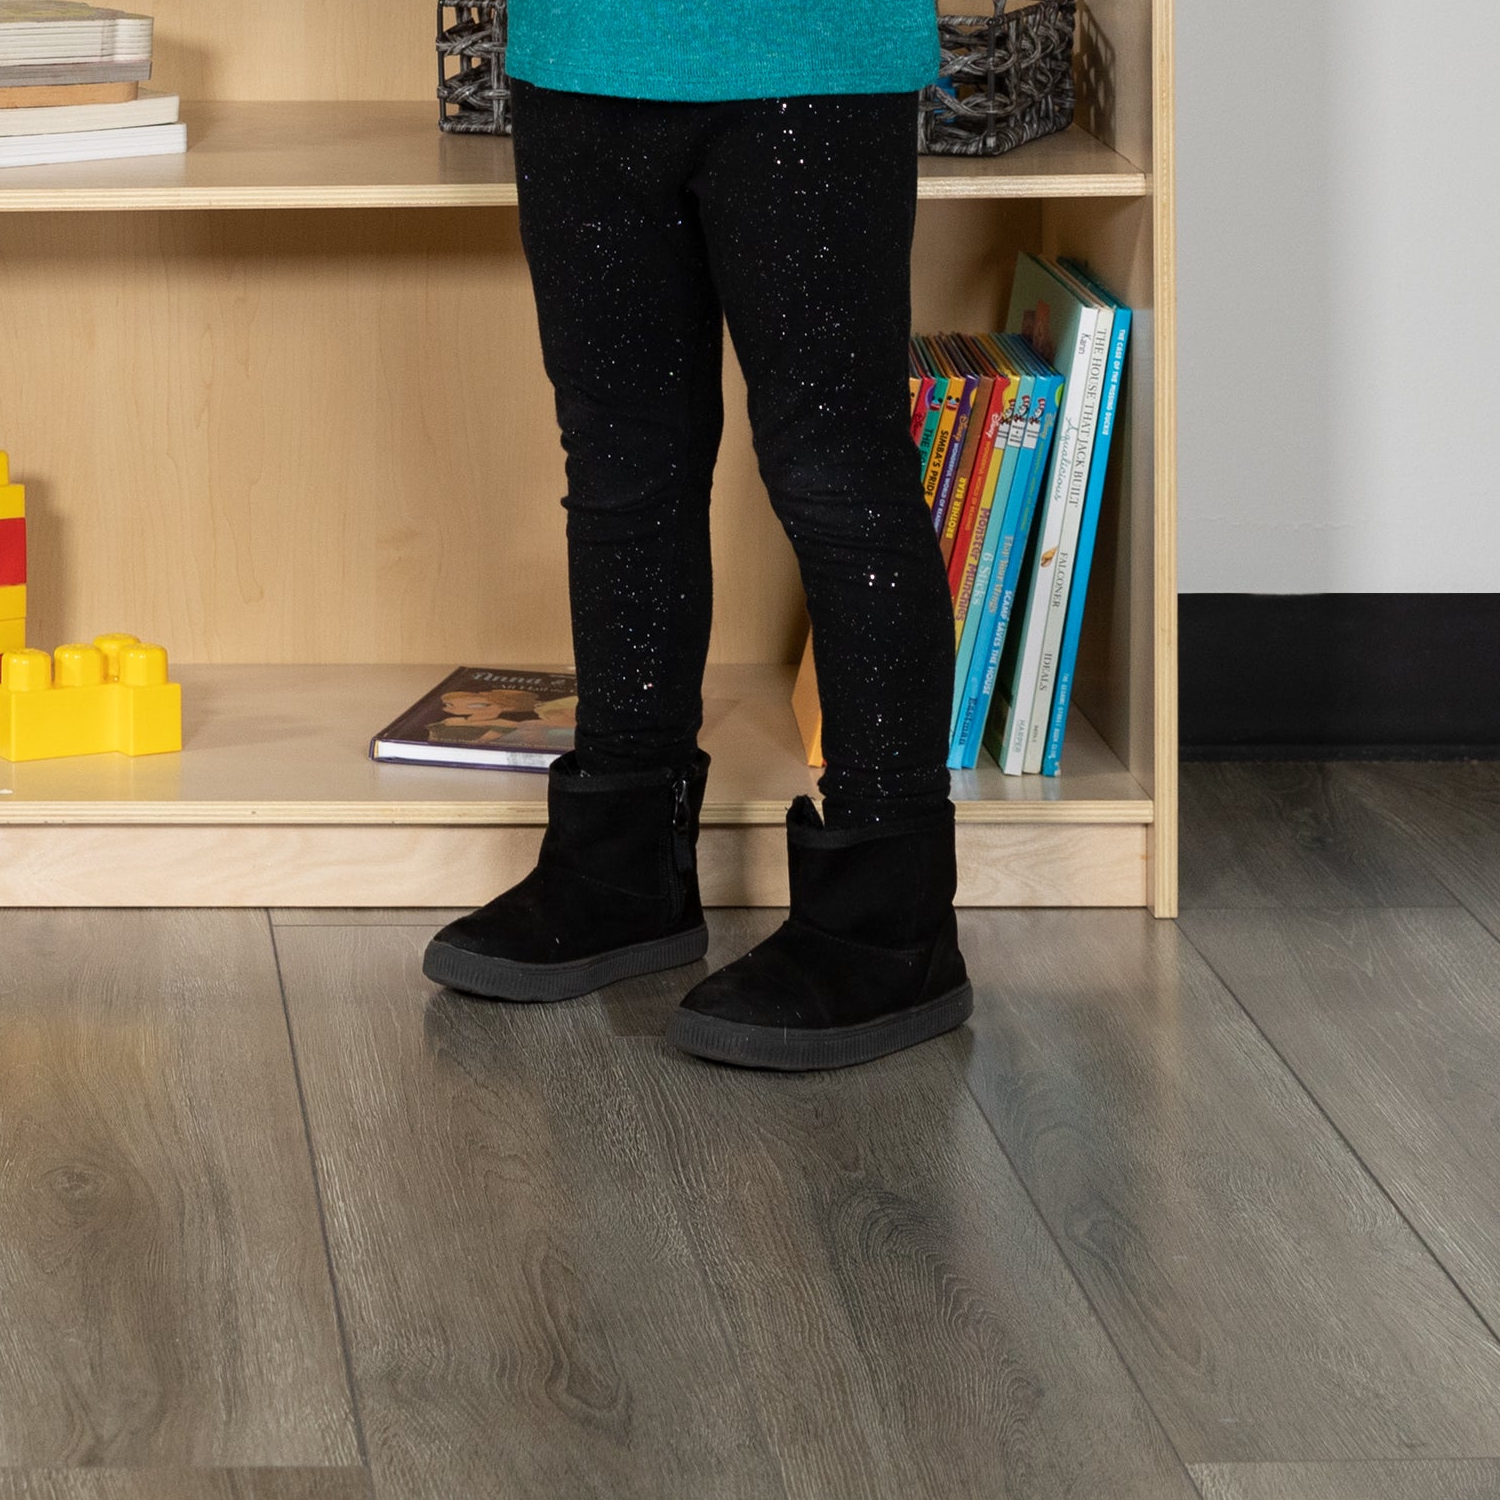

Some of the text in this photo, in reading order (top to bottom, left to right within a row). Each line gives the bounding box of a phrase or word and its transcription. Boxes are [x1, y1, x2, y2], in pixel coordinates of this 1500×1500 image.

[1116, 342, 1124, 360] CASE
[1118, 329, 1126, 342] THE
[1111, 371, 1119, 383] THE
[1114, 361, 1121, 370] OF
[1106, 382, 1118, 410] MISSING
[986, 413, 1001, 438] Disney
[1053, 332, 1089, 501] Kann Aqualicious
[1069, 329, 1106, 507] THE HOUSE THAT JACK BUILT
[920, 428, 933, 448] THE
[924, 429, 949, 496] SIMBA'S PRIDE
[939, 443, 958, 511] WONDERFUL WORLD OF
[946, 477, 968, 539] BROTHER BEAR
[956, 507, 990, 622] Monster Munchies
[1052, 552, 1068, 608] FALCONER
[972, 565, 990, 605] Sticks
[981, 590, 1013, 696] SCAMP SAVES THE HOUSE
[1040, 653, 1052, 691] IDEALS
